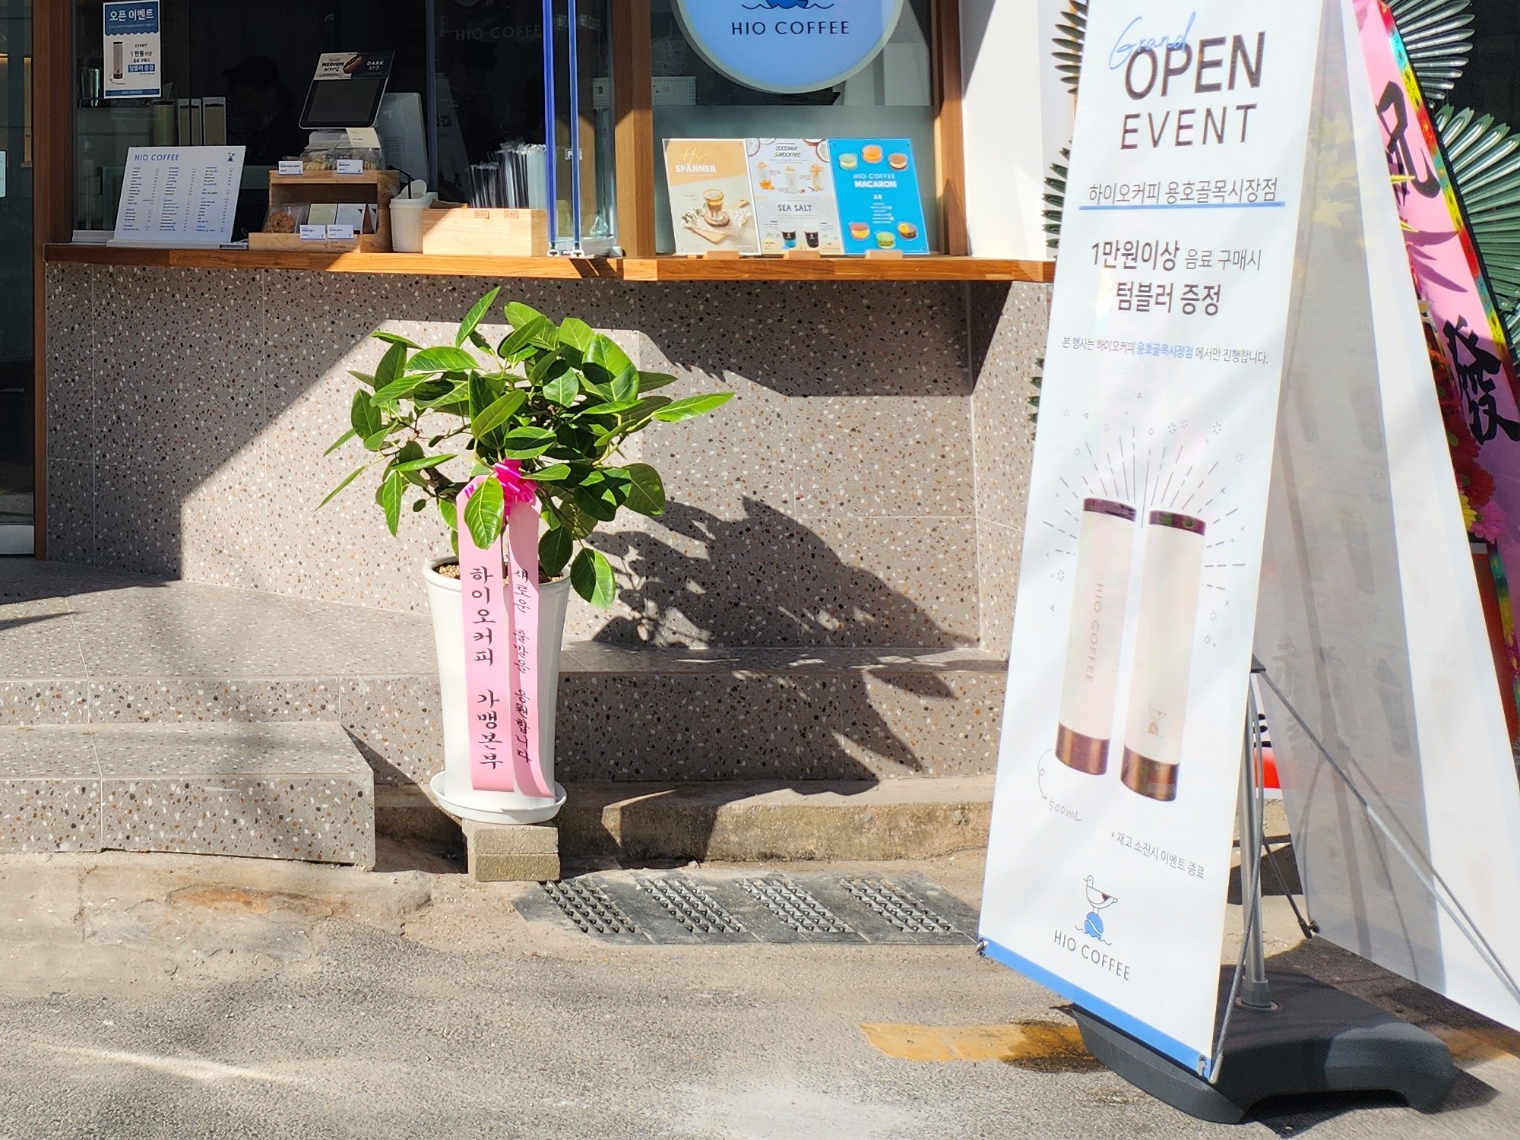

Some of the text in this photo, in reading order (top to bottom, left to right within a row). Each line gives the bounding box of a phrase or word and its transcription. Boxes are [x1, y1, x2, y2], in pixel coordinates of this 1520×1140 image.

[108, 8, 155, 22] 오픈 이벤트
[731, 20, 850, 35] HIO COFFEE
[490, 24, 542, 40] COFFE
[1108, 11, 1197, 71] Grand
[1124, 30, 1266, 101] OPEN
[1121, 103, 1258, 150] EVENT
[134, 153, 180, 161] HIO COFFEE
[854, 180, 898, 188] MACARON
[1088, 177, 1279, 205] 하이오커피 용호골목시장점
[777, 204, 813, 212] SEA SALT
[1091, 238, 1262, 272] 1만원이상 음료 구매시
[1116, 281, 1223, 317] 텀블러 증정
[1072, 337, 1095, 351] 행사는
[1096, 338, 1135, 355] 하이오커피
[1136, 341, 1194, 360] 용호골목시장점
[1084, 582, 1104, 683] HIO COFFEE
[476, 689, 503, 769] 가맹본부
[1160, 850, 1186, 871] 이벤트
[1187, 861, 1206, 880] 종료
[1053, 929, 1131, 981] HIO COFFEE
